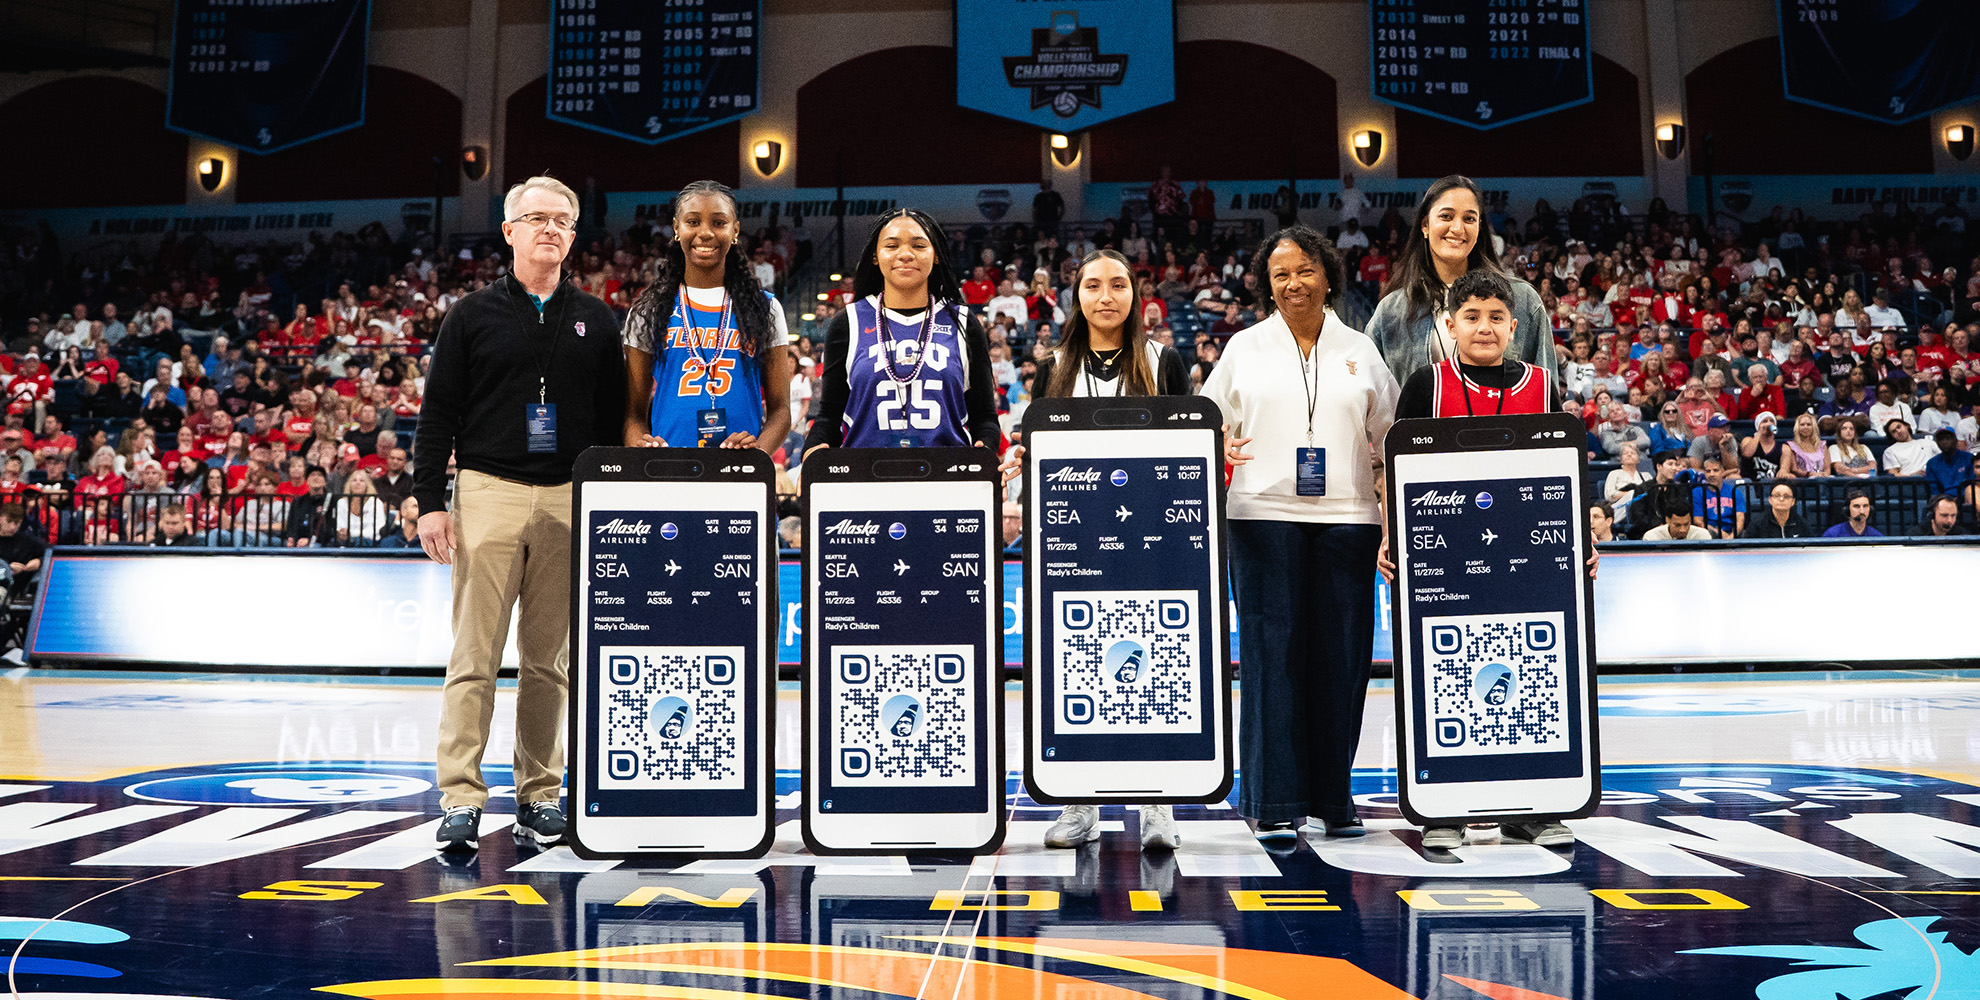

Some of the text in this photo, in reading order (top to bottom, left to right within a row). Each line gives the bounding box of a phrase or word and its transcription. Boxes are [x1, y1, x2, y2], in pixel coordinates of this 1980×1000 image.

[1488, 11, 1530, 25] 2020
[1378, 28, 1417, 42] 2014
[1489, 28, 1529, 42] 2021
[1378, 45, 1418, 59] 2015
[1490, 45, 1581, 60] 2022 FINAL 4
[1013, 63, 1120, 80] CHAMPIONSHIP
[1379, 62, 1419, 77] 2016
[1379, 80, 1417, 95] 2017
[1248, 192, 1322, 210] HOLAY
[664, 327, 757, 354] FLORID
[678, 358, 736, 396] 25
[877, 379, 941, 430] 25
[1048, 414, 1071, 423] 10:10
[1411, 436, 1433, 445] 10:10
[600, 465, 623, 474] 10:10
[828, 465, 851, 474] 10:10
[1046, 466, 1102, 484] Alaska
[1156, 471, 1169, 480] 34
[1177, 471, 1201, 480] 10:07
[1411, 489, 1467, 507] Alaska
[1521, 493, 1534, 502] 34
[1542, 491, 1565, 500] 10:07
[1164, 507, 1201, 524] SAN
[1416, 507, 1463, 516] AIRLINES
[1046, 509, 1081, 525] SEA
[595, 518, 653, 537] Alaska
[706, 526, 720, 535] 34
[727, 526, 752, 535] 10:07
[824, 518, 881, 537] Alaska
[934, 525, 947, 534] 34
[955, 525, 979, 534] 10:07
[600, 537, 648, 545] AIRLINES
[829, 537, 876, 545] AIRLINES
[1530, 528, 1566, 545] SAN
[1098, 542, 1125, 550] AS336
[1143, 542, 1151, 550] A
[1193, 542, 1203, 550] 1A
[1413, 533, 1448, 550] SEA
[1046, 543, 1077, 551] 11/27/25
[595, 562, 630, 579] SEA
[713, 562, 751, 579] SAN
[825, 562, 859, 578] SEA
[942, 561, 979, 578] SAN
[1465, 566, 1491, 574] AS336
[1509, 565, 1517, 573] A
[1559, 562, 1568, 570] 1A
[1047, 568, 1102, 577] Rady's Children
[1414, 568, 1445, 577] 11/27/25
[594, 597, 626, 605] 11/27/25
[646, 597, 673, 605] AS336
[691, 597, 699, 605] A
[741, 597, 752, 605] 1A
[825, 597, 855, 605] 11/27/25
[920, 596, 928, 604] A
[970, 596, 980, 604] 1A
[1415, 593, 1470, 603] Rady's Children
[594, 623, 651, 632] Rady's Children
[825, 622, 880, 632] Rady's Children
